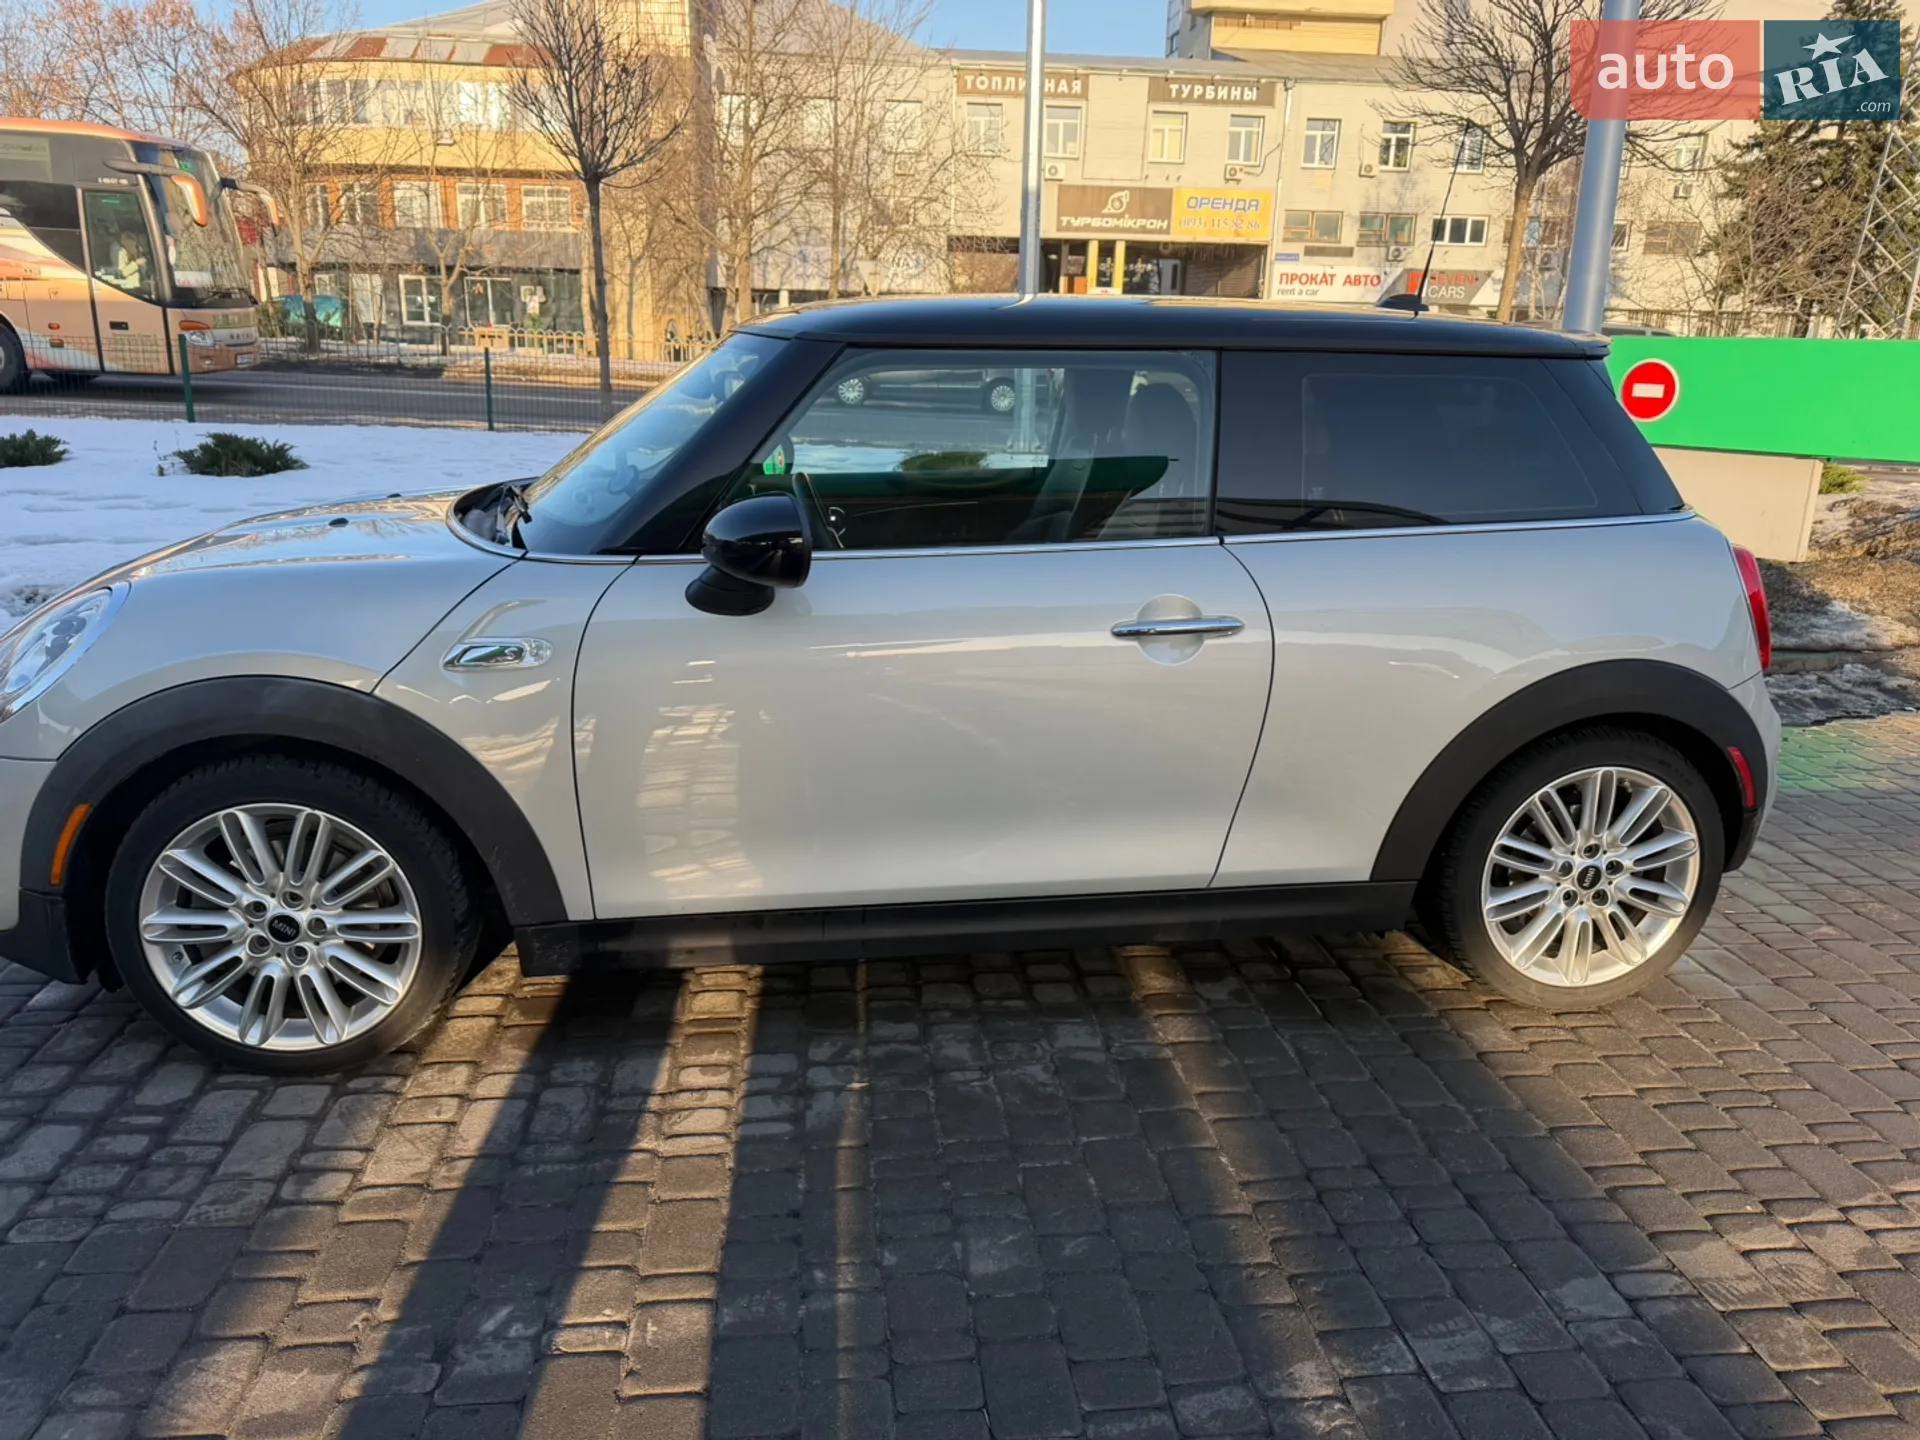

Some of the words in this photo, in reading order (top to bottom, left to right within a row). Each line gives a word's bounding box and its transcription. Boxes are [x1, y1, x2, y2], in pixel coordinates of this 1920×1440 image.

[964, 75, 1082, 94] ТОПЛИНАЯ
[1169, 84, 1257, 101] ТУРБИНЫ
[1186, 196, 1260, 213] ОРЕНДА
[1279, 272, 1336, 287] ПРОКАТ
[1342, 274, 1382, 287] АВТО
[1277, 287, 1296, 296] rent
[1305, 289, 1320, 297] car
[1427, 285, 1465, 299] CARS
[271, 919, 297, 938] MINI
